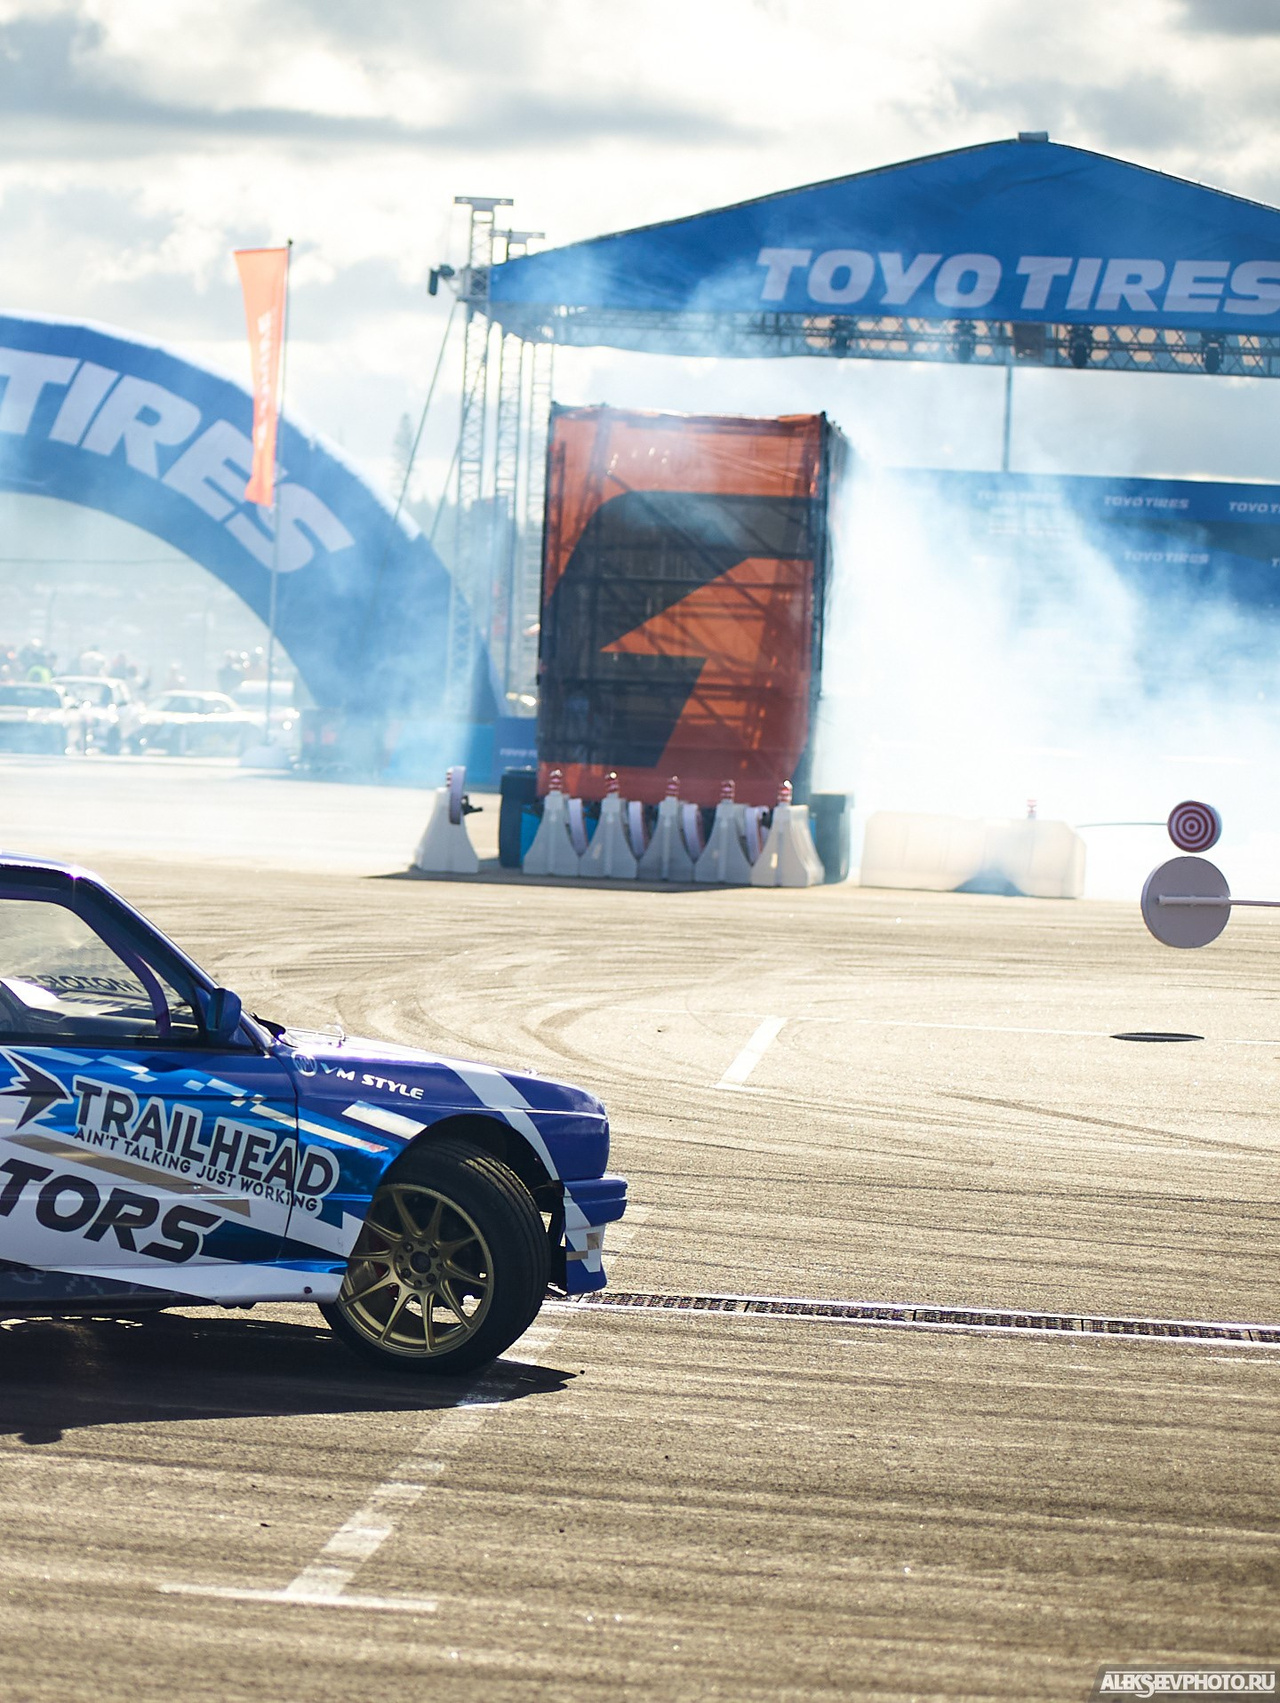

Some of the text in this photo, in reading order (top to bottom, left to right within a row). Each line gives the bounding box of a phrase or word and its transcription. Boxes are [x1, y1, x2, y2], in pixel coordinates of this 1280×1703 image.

[757, 247, 1280, 314] TOYO TIRES
[1104, 495, 1190, 509] TOYO TIRES
[1229, 501, 1269, 513] TOYO
[1124, 550, 1210, 564] TOYO TIRES
[361, 1074, 424, 1101] STYLE
[75, 1080, 334, 1197] TRAILHEAD
[74, 1127, 318, 1212] AIN'T TALKING JUST WORKING
